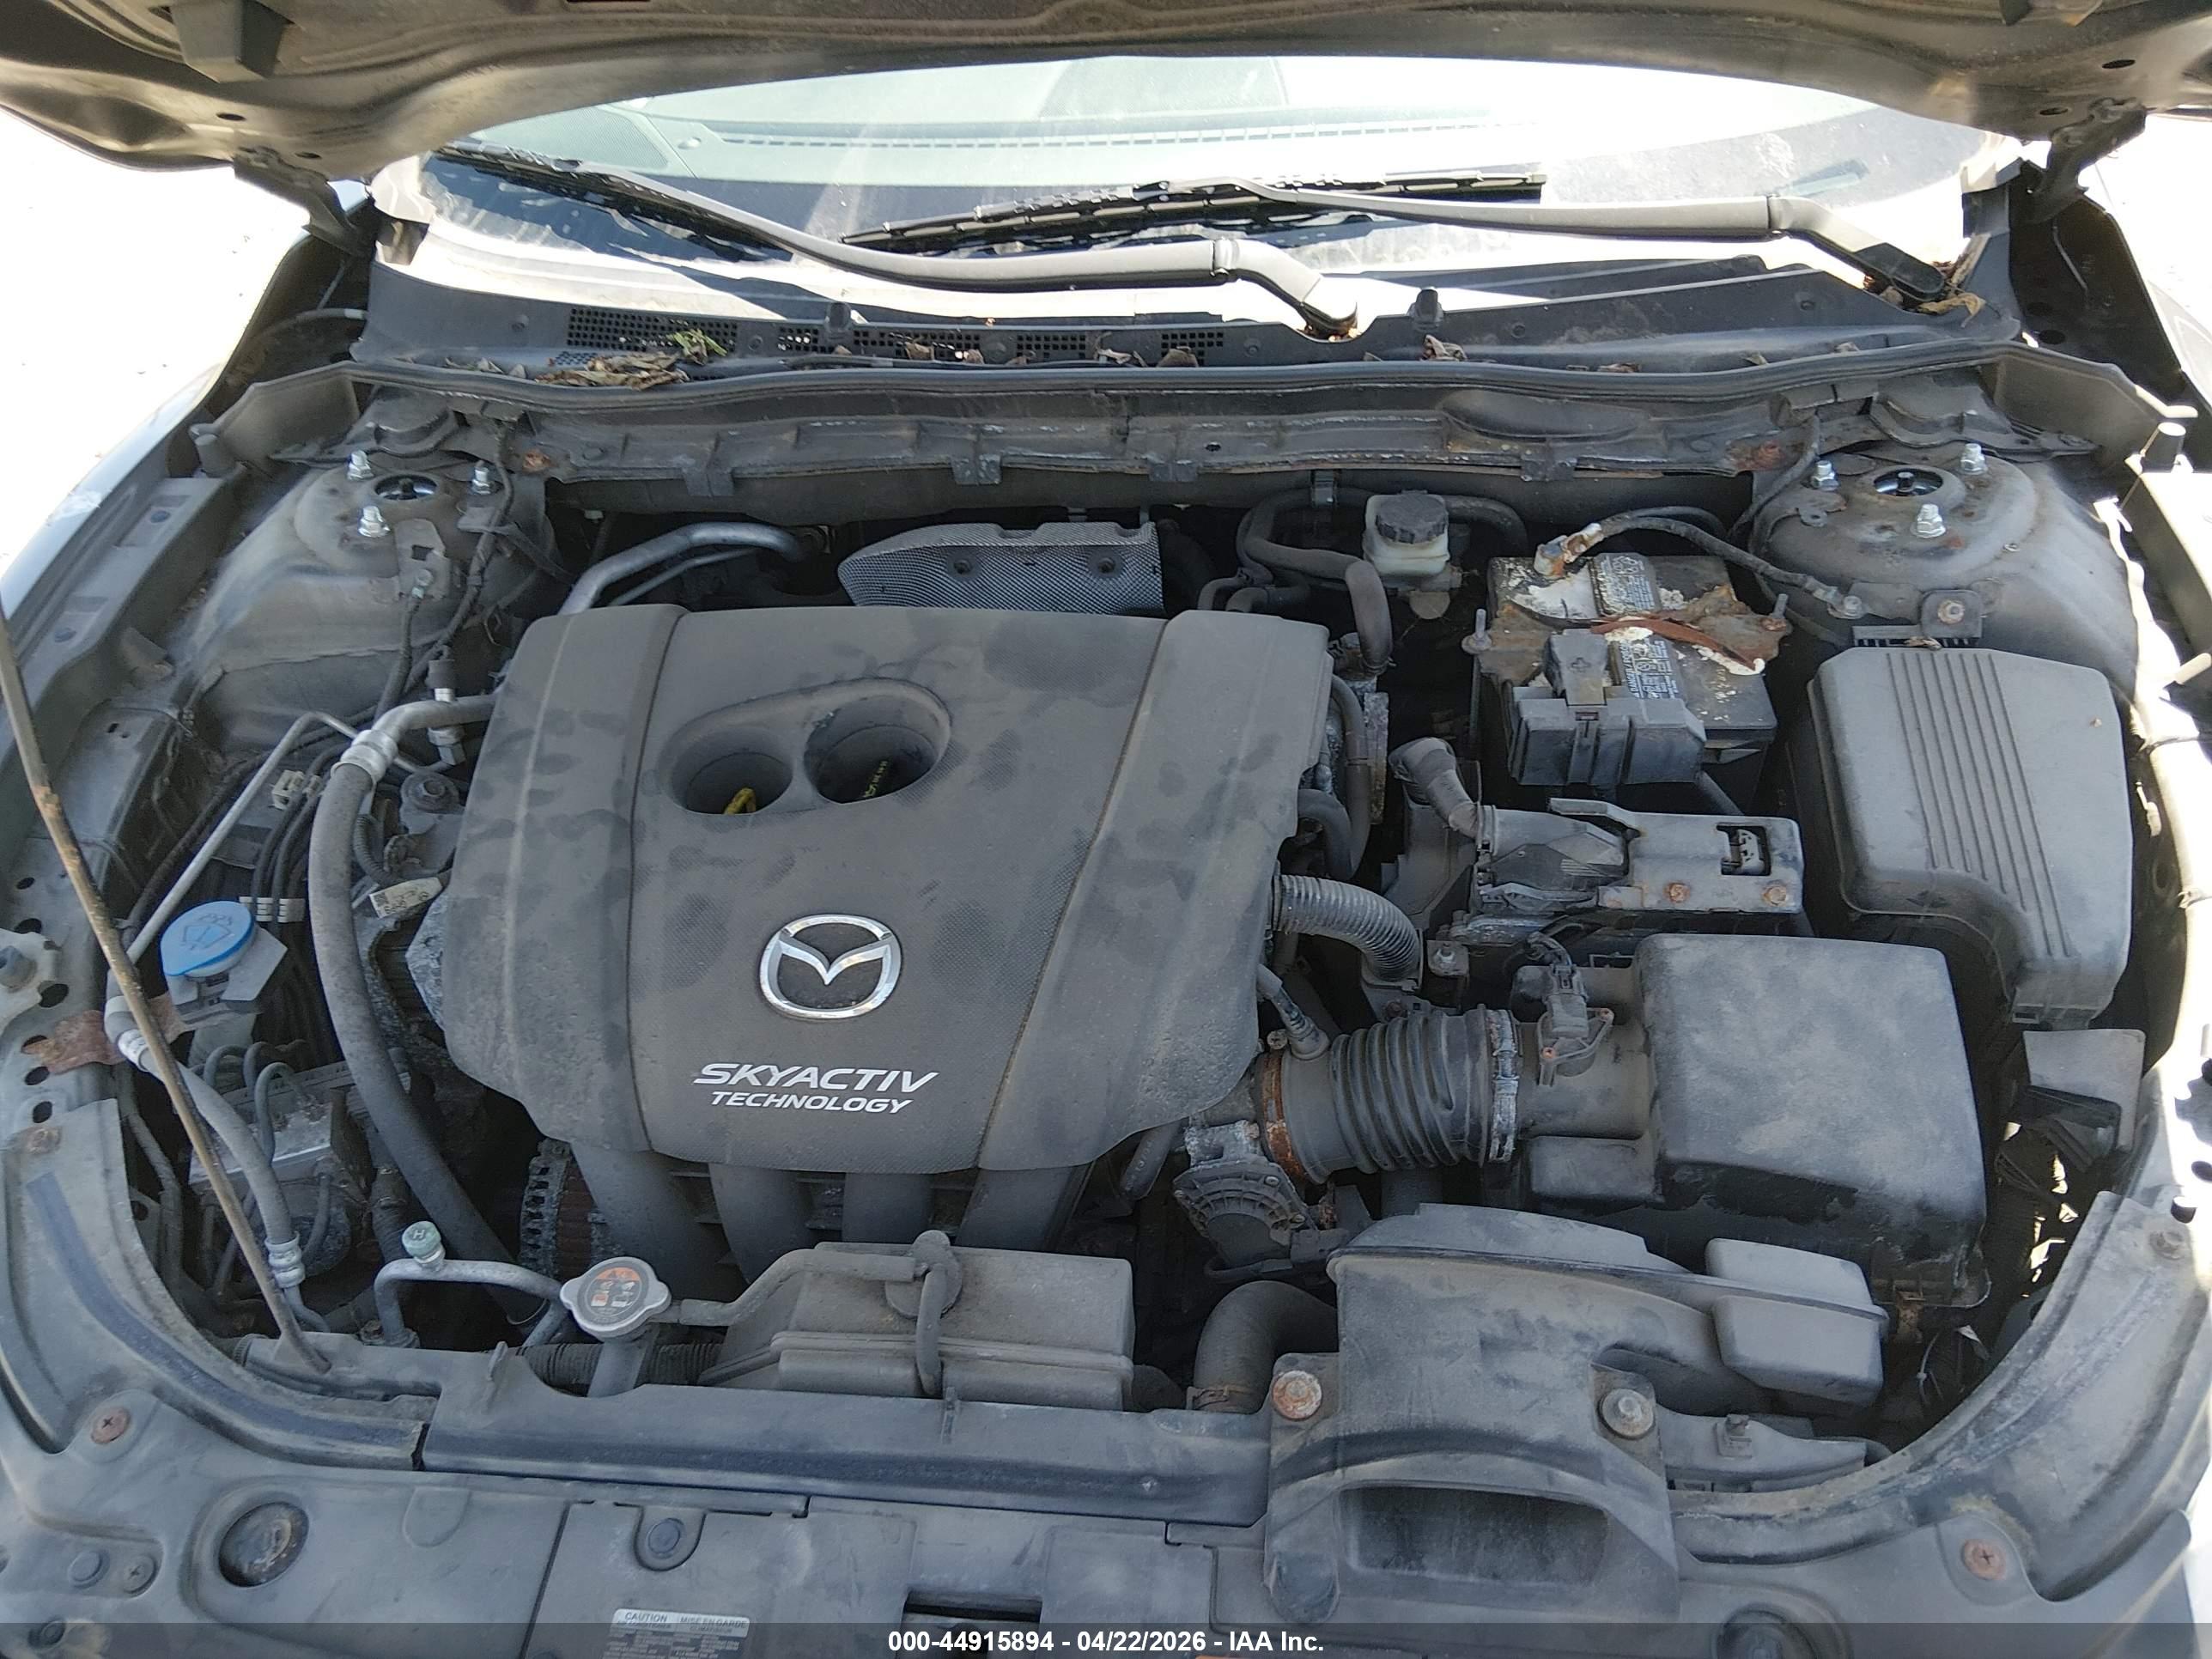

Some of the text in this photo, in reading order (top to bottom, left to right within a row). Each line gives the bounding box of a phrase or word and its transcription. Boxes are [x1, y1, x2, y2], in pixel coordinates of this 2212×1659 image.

[693, 1063, 939, 1093] SKYACTIV
[711, 1091, 914, 1114] TECHNOLOGY
[412, 1230, 426, 1241] H
[625, 1612, 667, 1622] CAUTION
